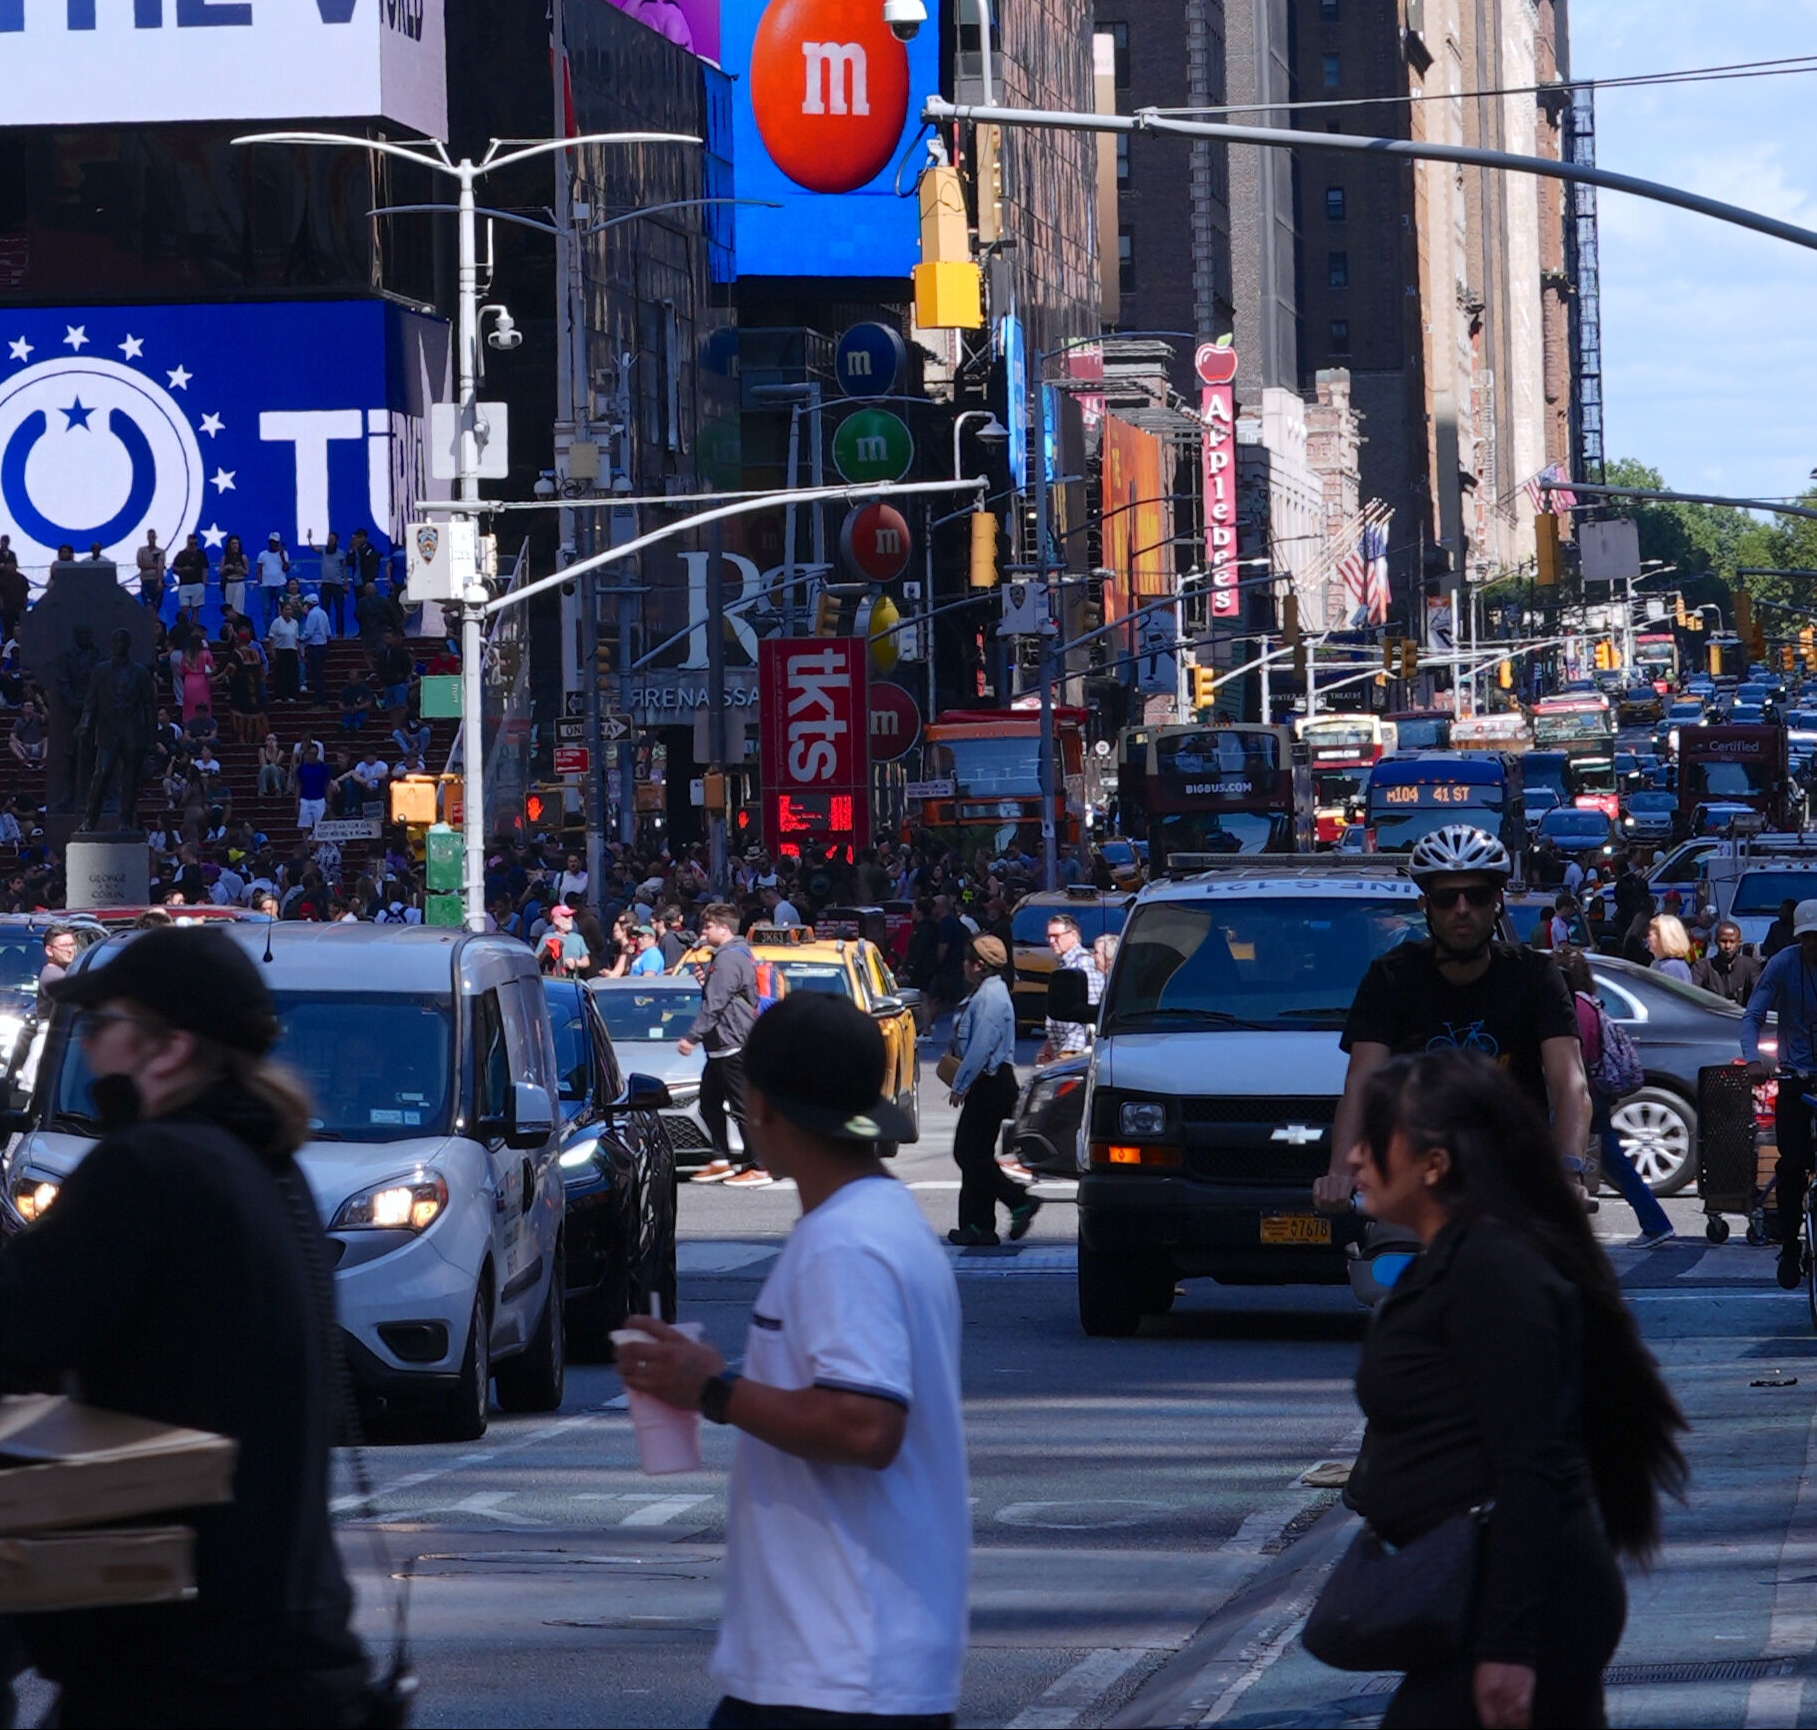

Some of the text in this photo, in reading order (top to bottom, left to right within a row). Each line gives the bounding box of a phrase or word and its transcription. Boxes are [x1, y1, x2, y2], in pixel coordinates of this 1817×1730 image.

[801, 41, 870, 116] m
[847, 350, 872, 376] m
[856, 435, 888, 461] m
[875, 527, 900, 554] m
[787, 647, 851, 782] tkts
[869, 704, 900, 736] m
[565, 725, 584, 736] ON
[1709, 740, 1761, 752] Certified
[1185, 781, 1253, 795] BIGBUS.COM
[1386, 787, 1471, 804] M104 41 ST
